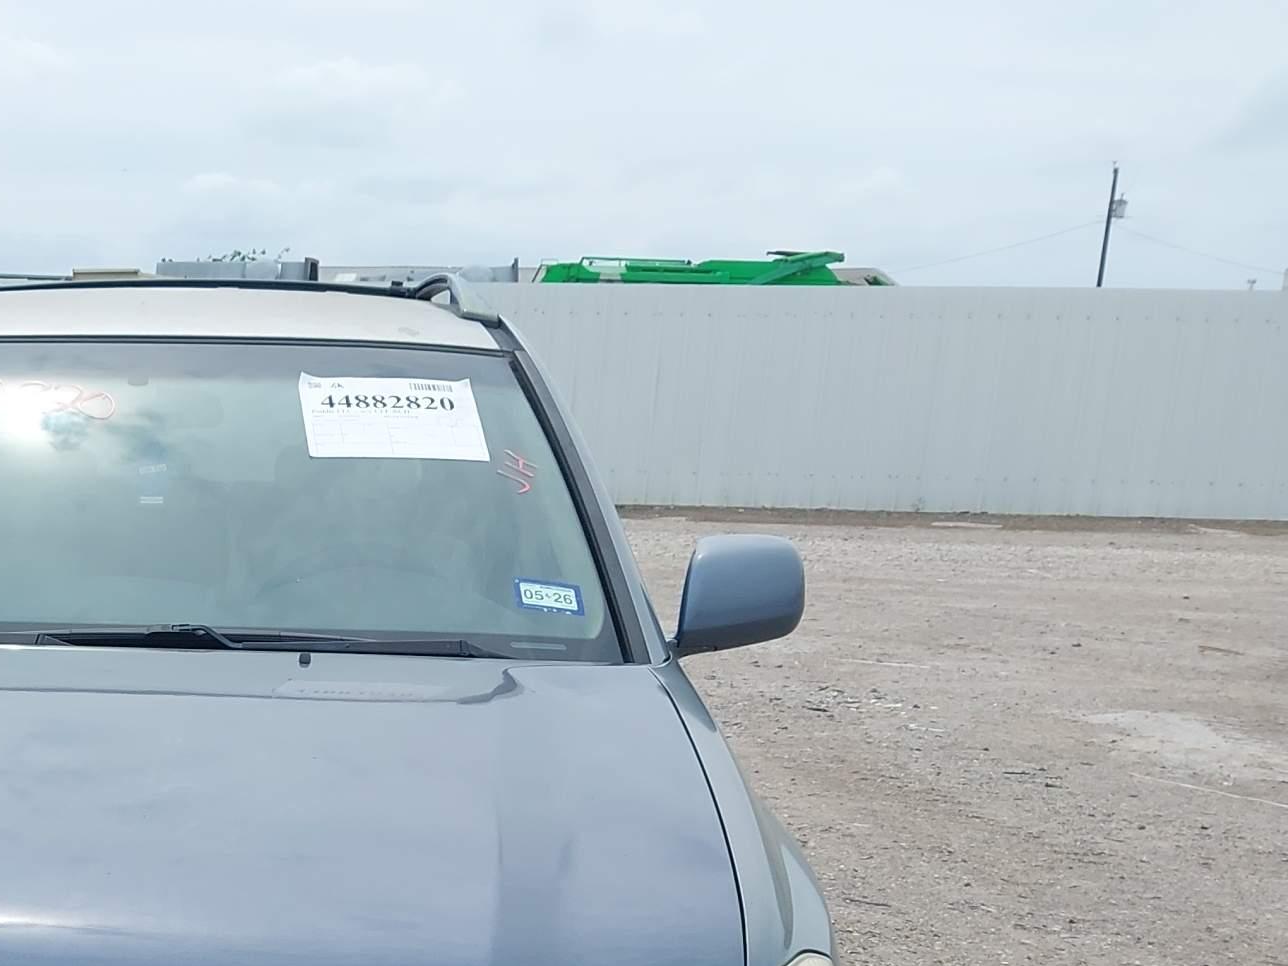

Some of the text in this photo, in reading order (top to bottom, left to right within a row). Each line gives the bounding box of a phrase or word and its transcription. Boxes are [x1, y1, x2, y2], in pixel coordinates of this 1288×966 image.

[320, 394, 456, 412] 44882820
[523, 588, 545, 601] 05
[552, 592, 574, 605] 26
